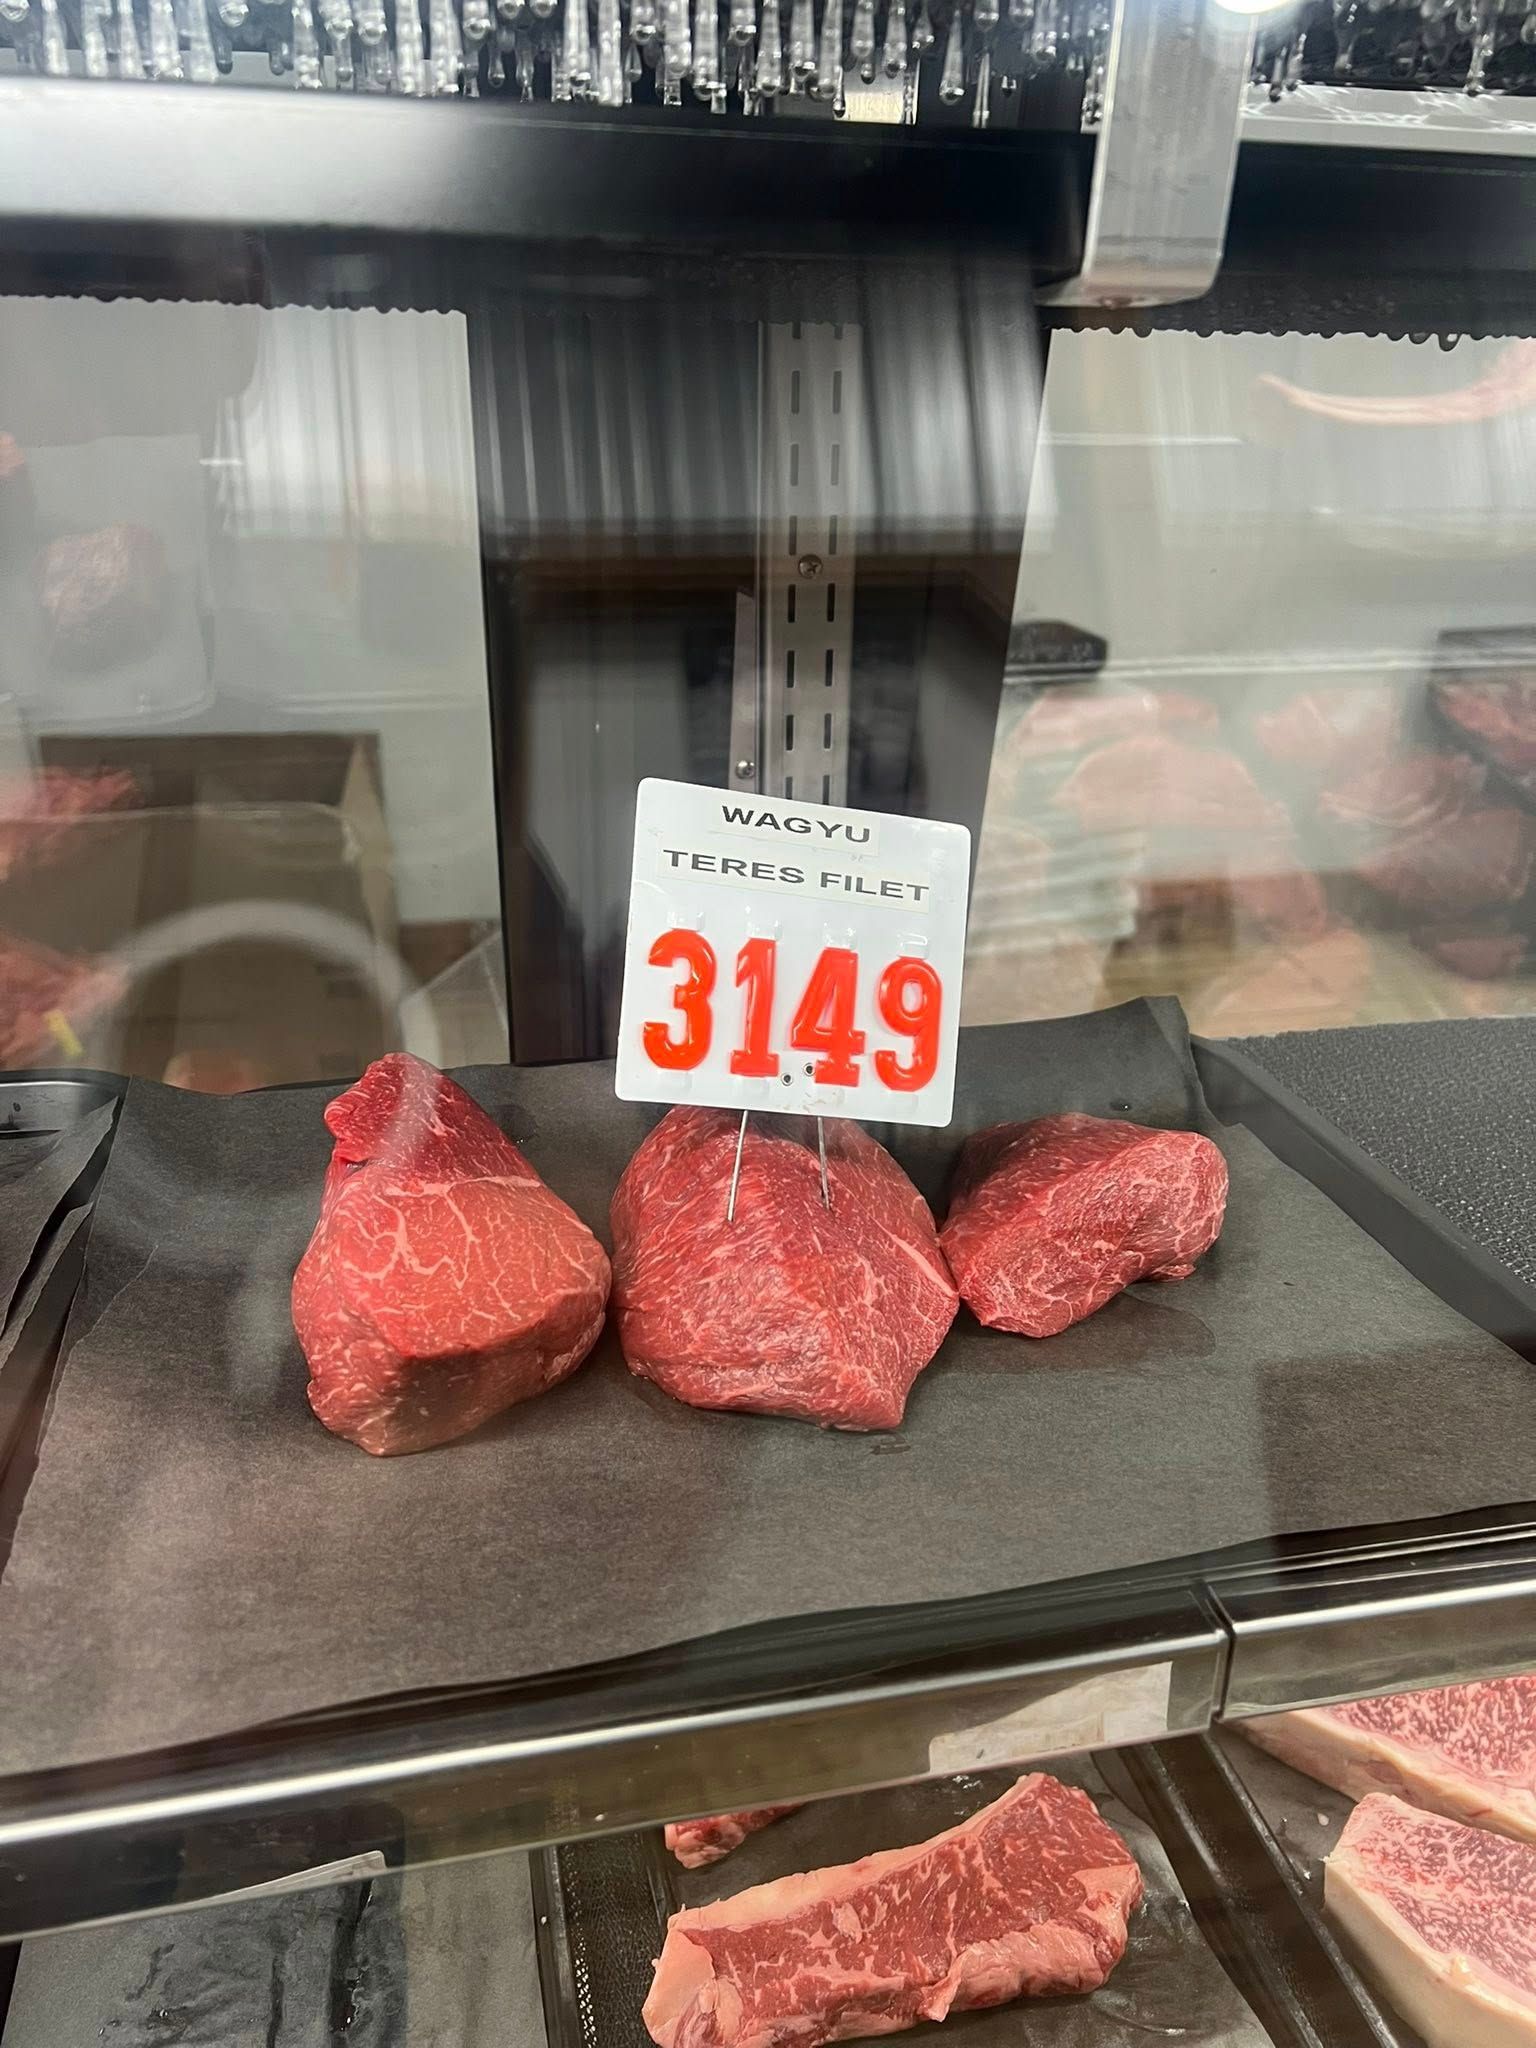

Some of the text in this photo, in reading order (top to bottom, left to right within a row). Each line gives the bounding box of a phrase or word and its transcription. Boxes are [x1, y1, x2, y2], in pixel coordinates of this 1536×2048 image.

[722, 805, 870, 844] WAGYU
[663, 849, 929, 902] TERES FILET
